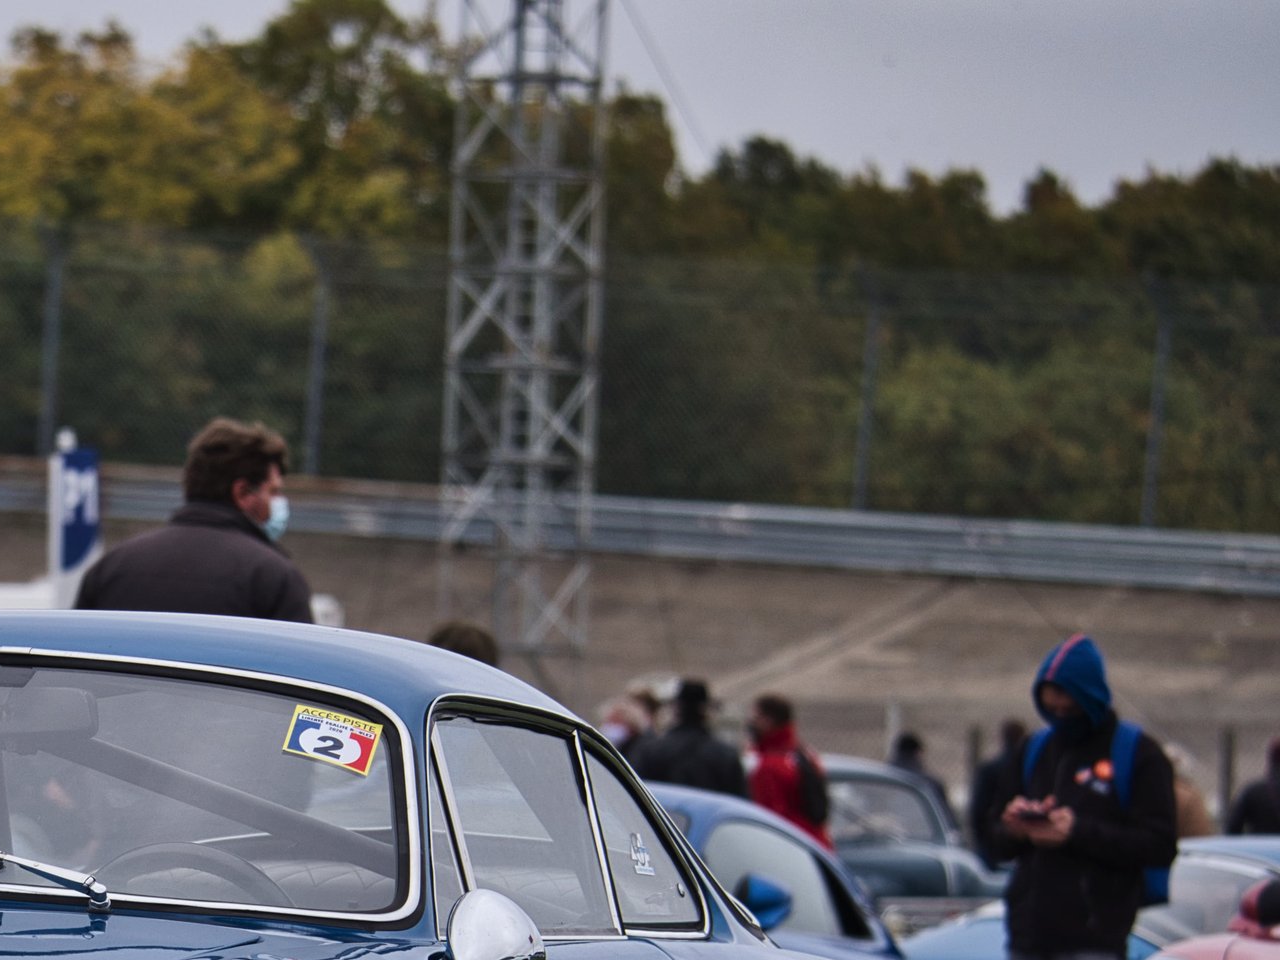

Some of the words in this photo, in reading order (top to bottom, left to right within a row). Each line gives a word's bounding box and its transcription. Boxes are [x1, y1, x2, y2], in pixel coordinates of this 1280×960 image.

[302, 708, 340, 722] ACCÈS
[343, 716, 376, 732] PISTE
[313, 735, 344, 760] 2
